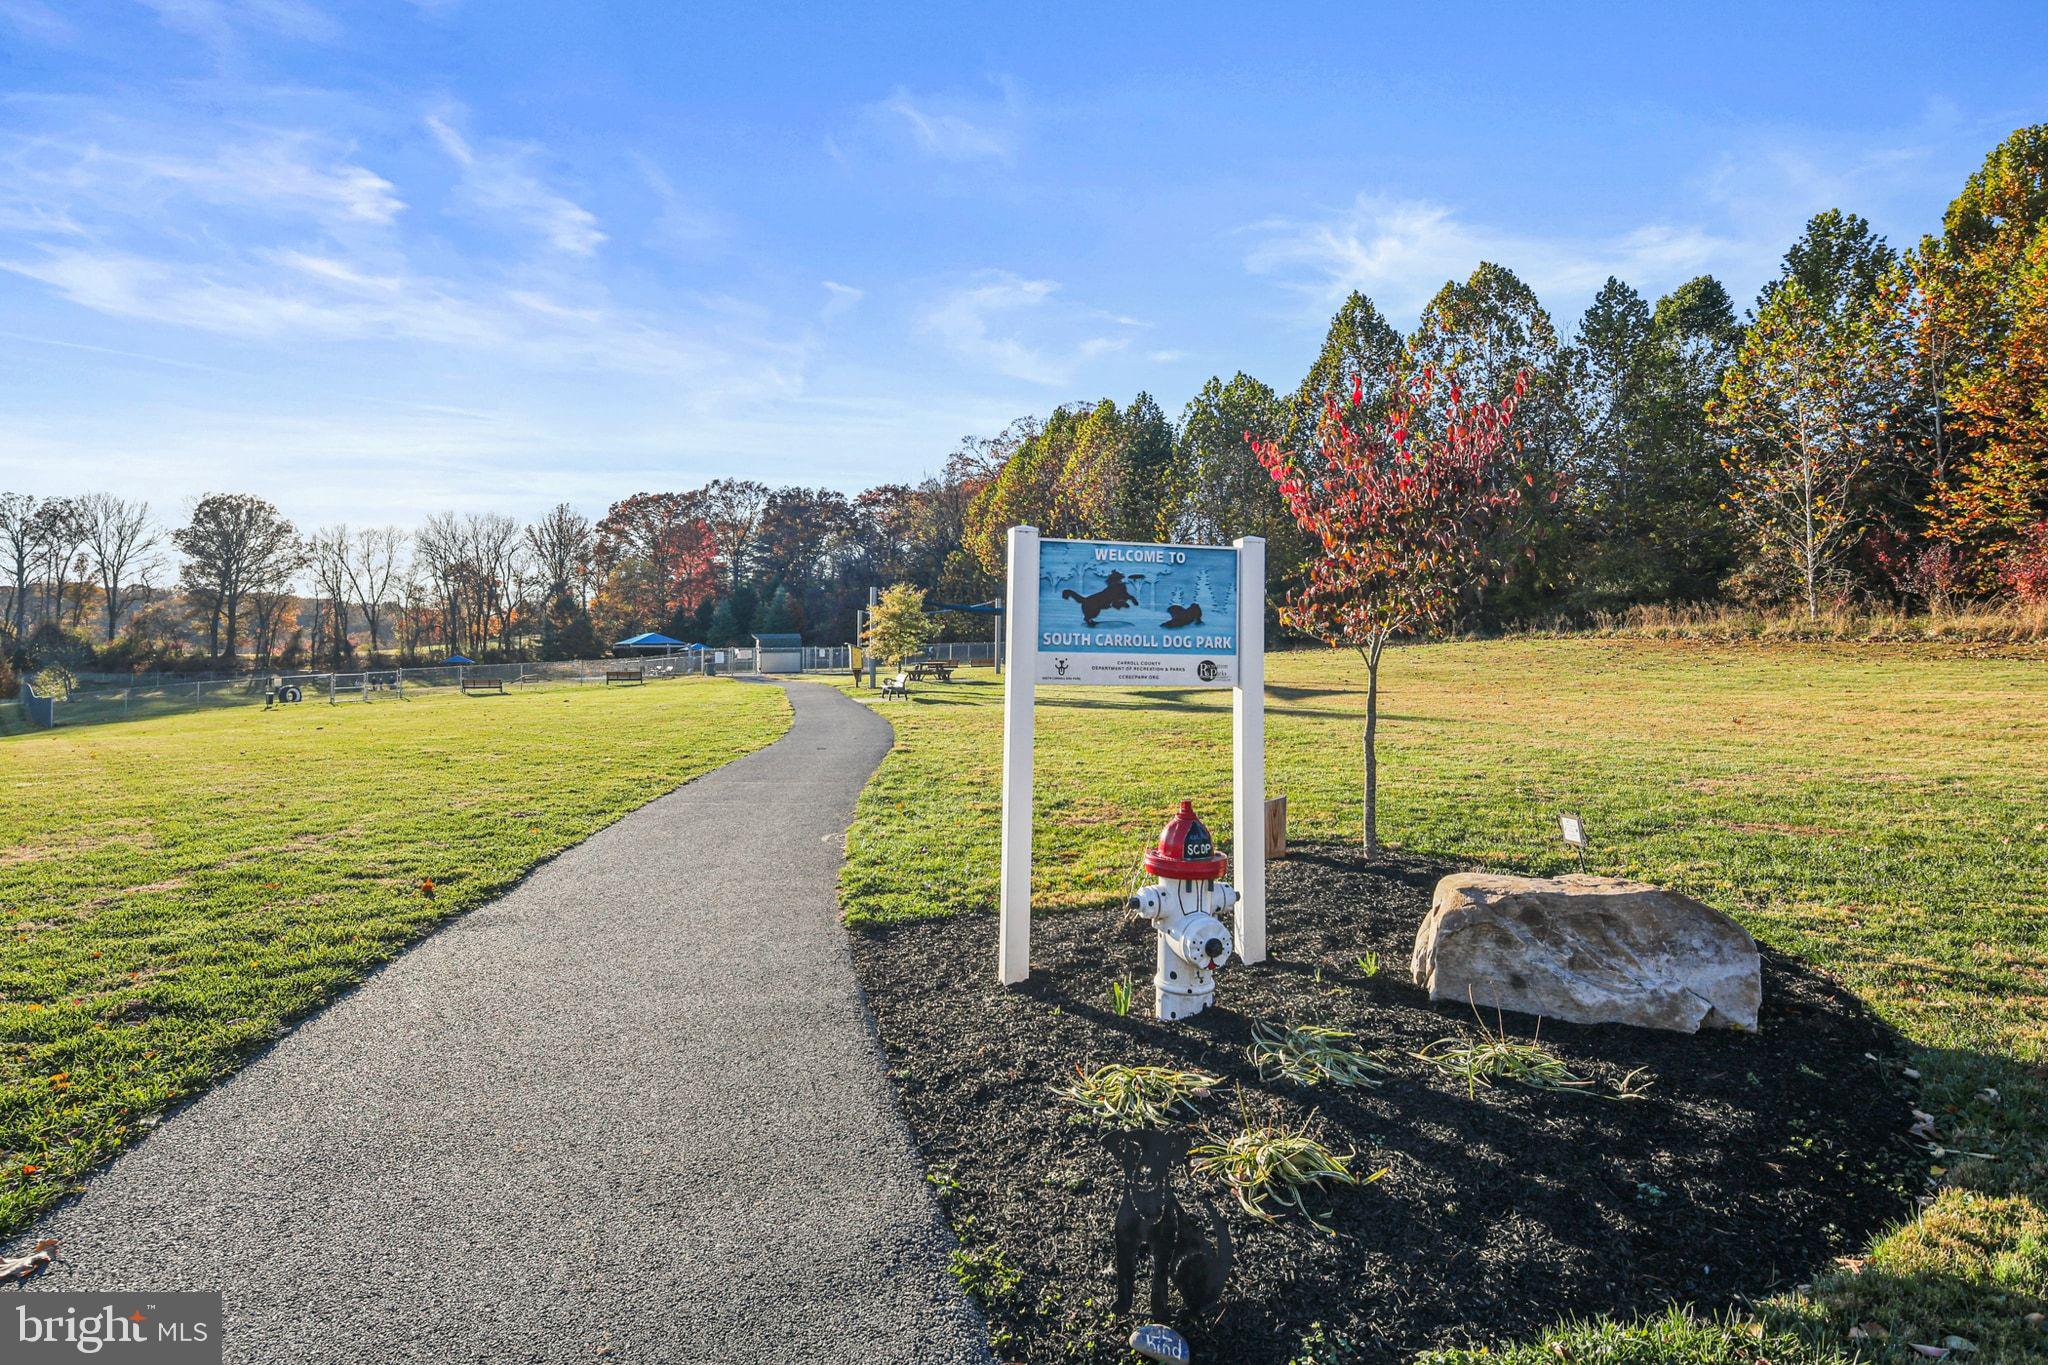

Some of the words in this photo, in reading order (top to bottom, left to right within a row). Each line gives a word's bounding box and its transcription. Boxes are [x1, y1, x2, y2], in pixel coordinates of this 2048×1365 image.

[1094, 548, 1164, 563] WELCOME
[1169, 551, 1186, 564] TO
[1043, 632, 1091, 646] SOUTH
[1095, 633, 1159, 648] CARROLL
[1162, 635, 1192, 649] DOG
[1196, 636, 1232, 649] PARK
